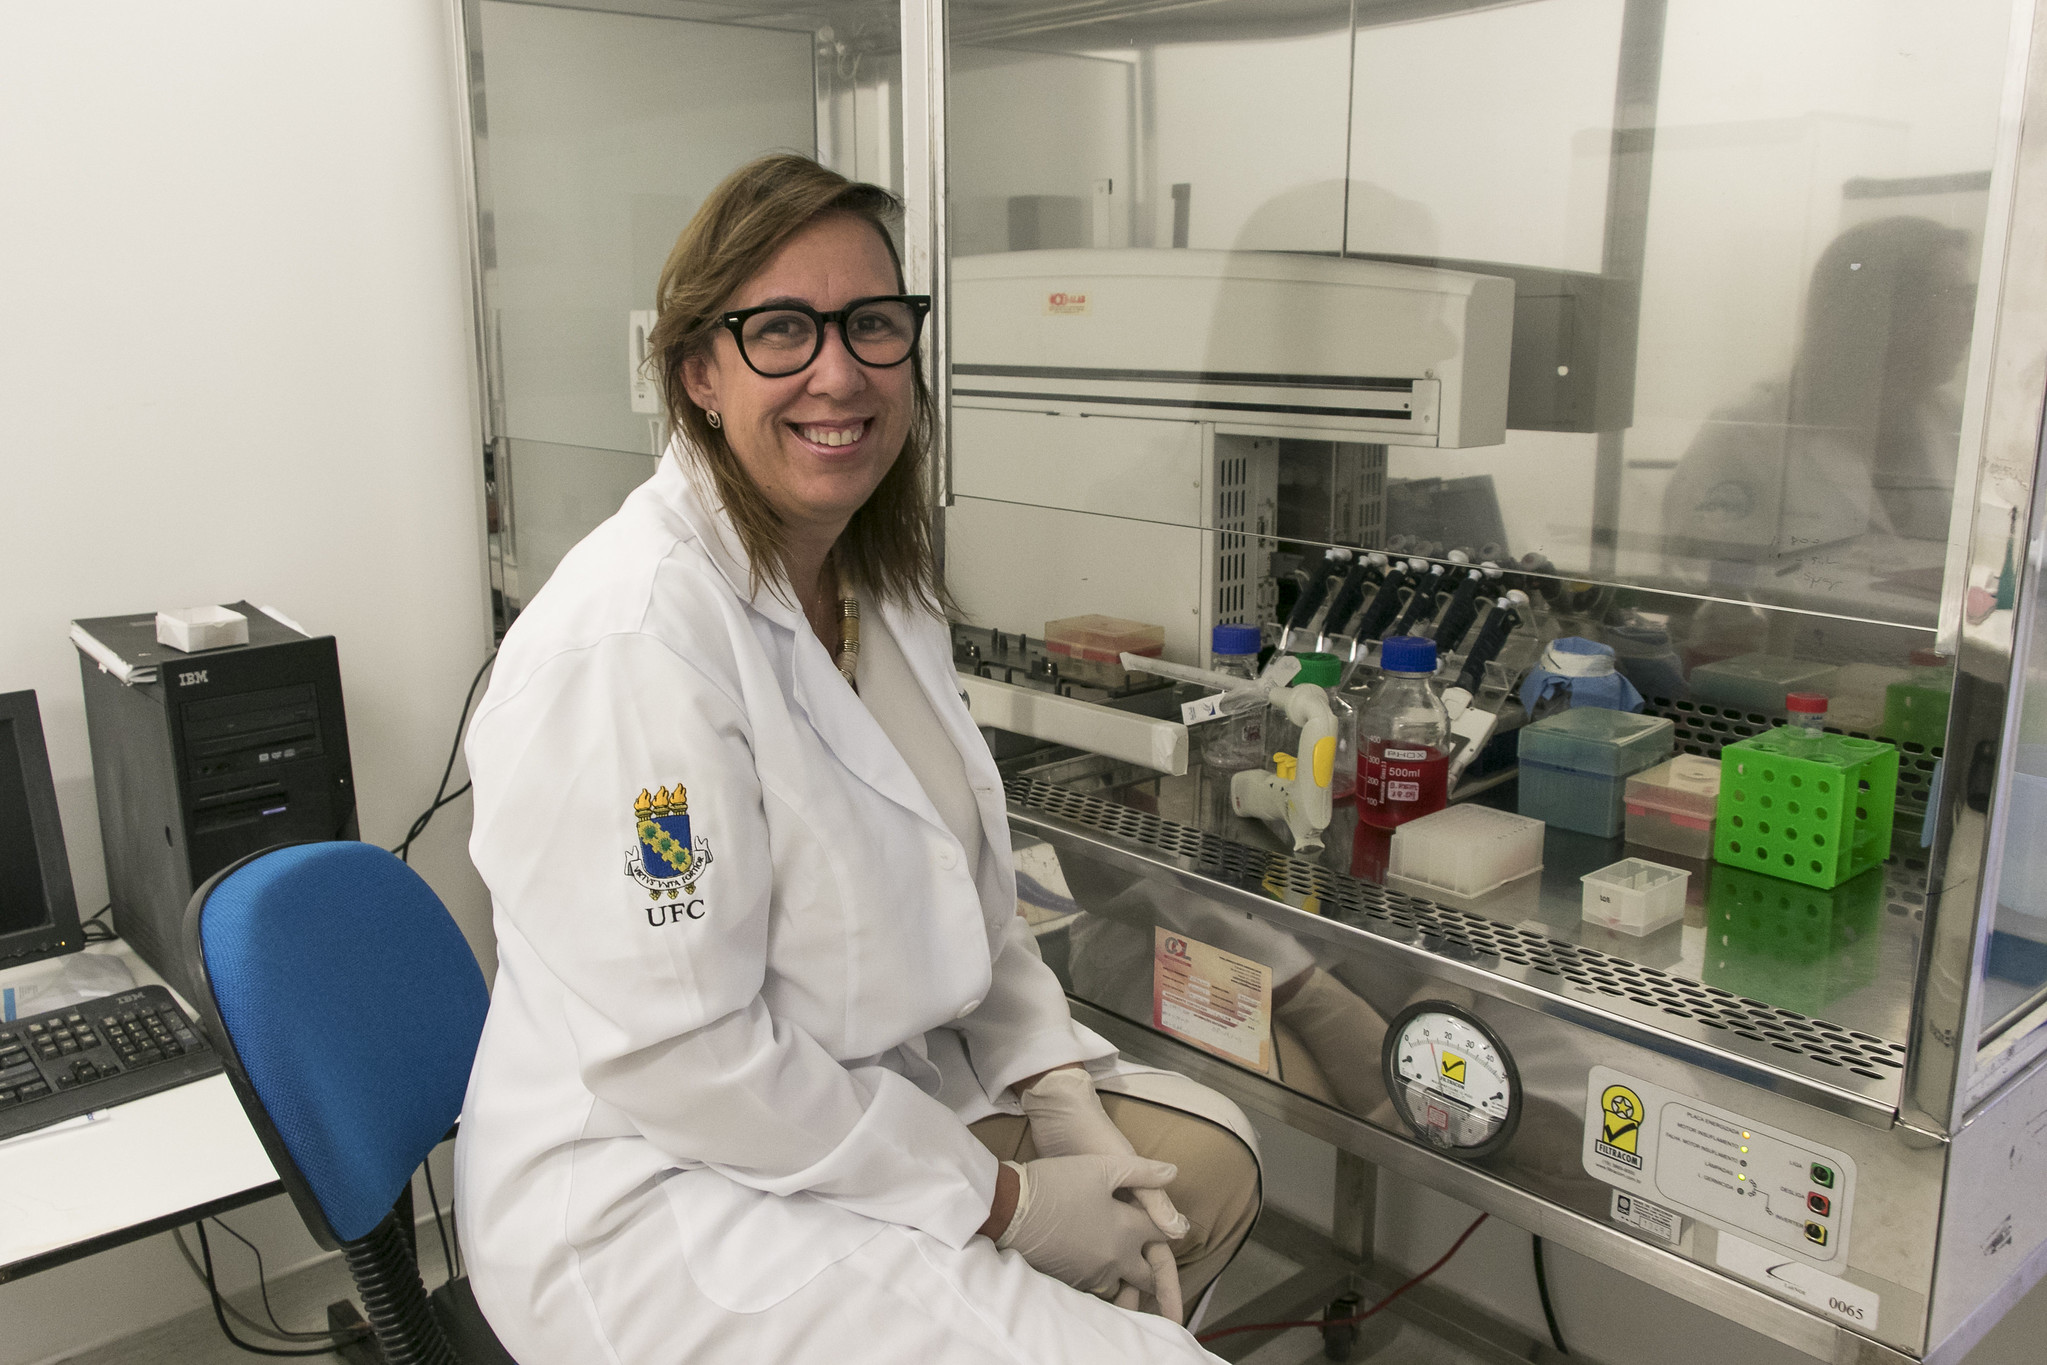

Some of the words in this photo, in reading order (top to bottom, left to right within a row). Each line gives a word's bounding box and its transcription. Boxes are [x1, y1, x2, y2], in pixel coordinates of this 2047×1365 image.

[178, 669, 209, 687] IBM
[1368, 734, 1381, 744] 400
[1368, 755, 1380, 765] 300
[1388, 767, 1420, 778] 500ml
[1367, 776, 1379, 786] 200
[1366, 797, 1378, 807] 100
[645, 899, 706, 927] UFC
[1423, 1028, 1430, 1037] 10
[1444, 1031, 1453, 1041] 20
[1465, 1039, 1475, 1049] 30
[1485, 1054, 1495, 1063] 40
[1599, 1144, 1638, 1166] FILTRACOM
[1780, 1186, 1805, 1199] DESLIGA
[1828, 1296, 1864, 1320] 0065
